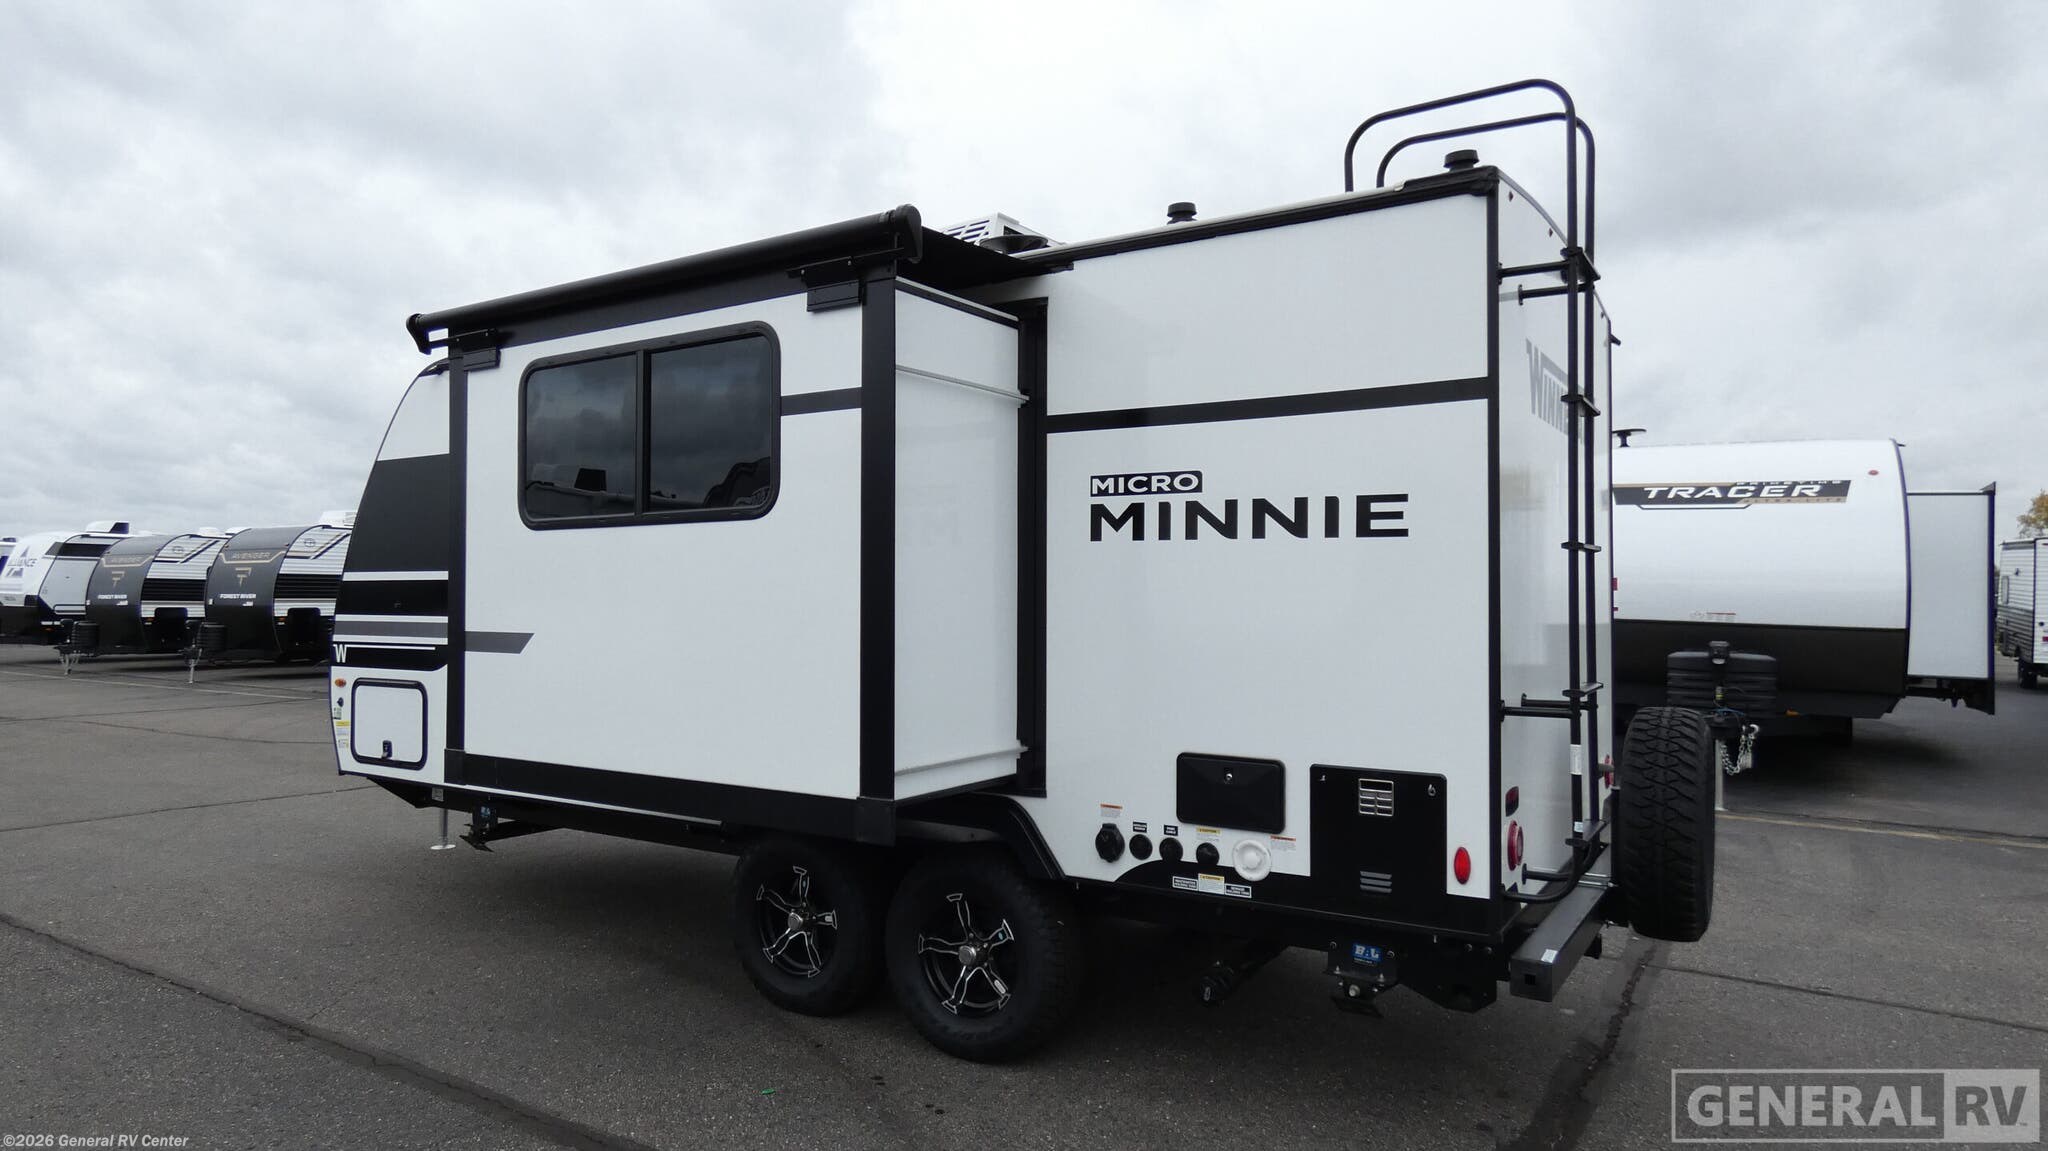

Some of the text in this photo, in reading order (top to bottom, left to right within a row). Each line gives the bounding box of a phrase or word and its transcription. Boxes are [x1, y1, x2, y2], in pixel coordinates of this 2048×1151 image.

[1091, 473, 1199, 495] MICRO
[1643, 485, 1823, 499] TRACER
[1090, 494, 1409, 541] MINNIE
[333, 643, 347, 663] W
